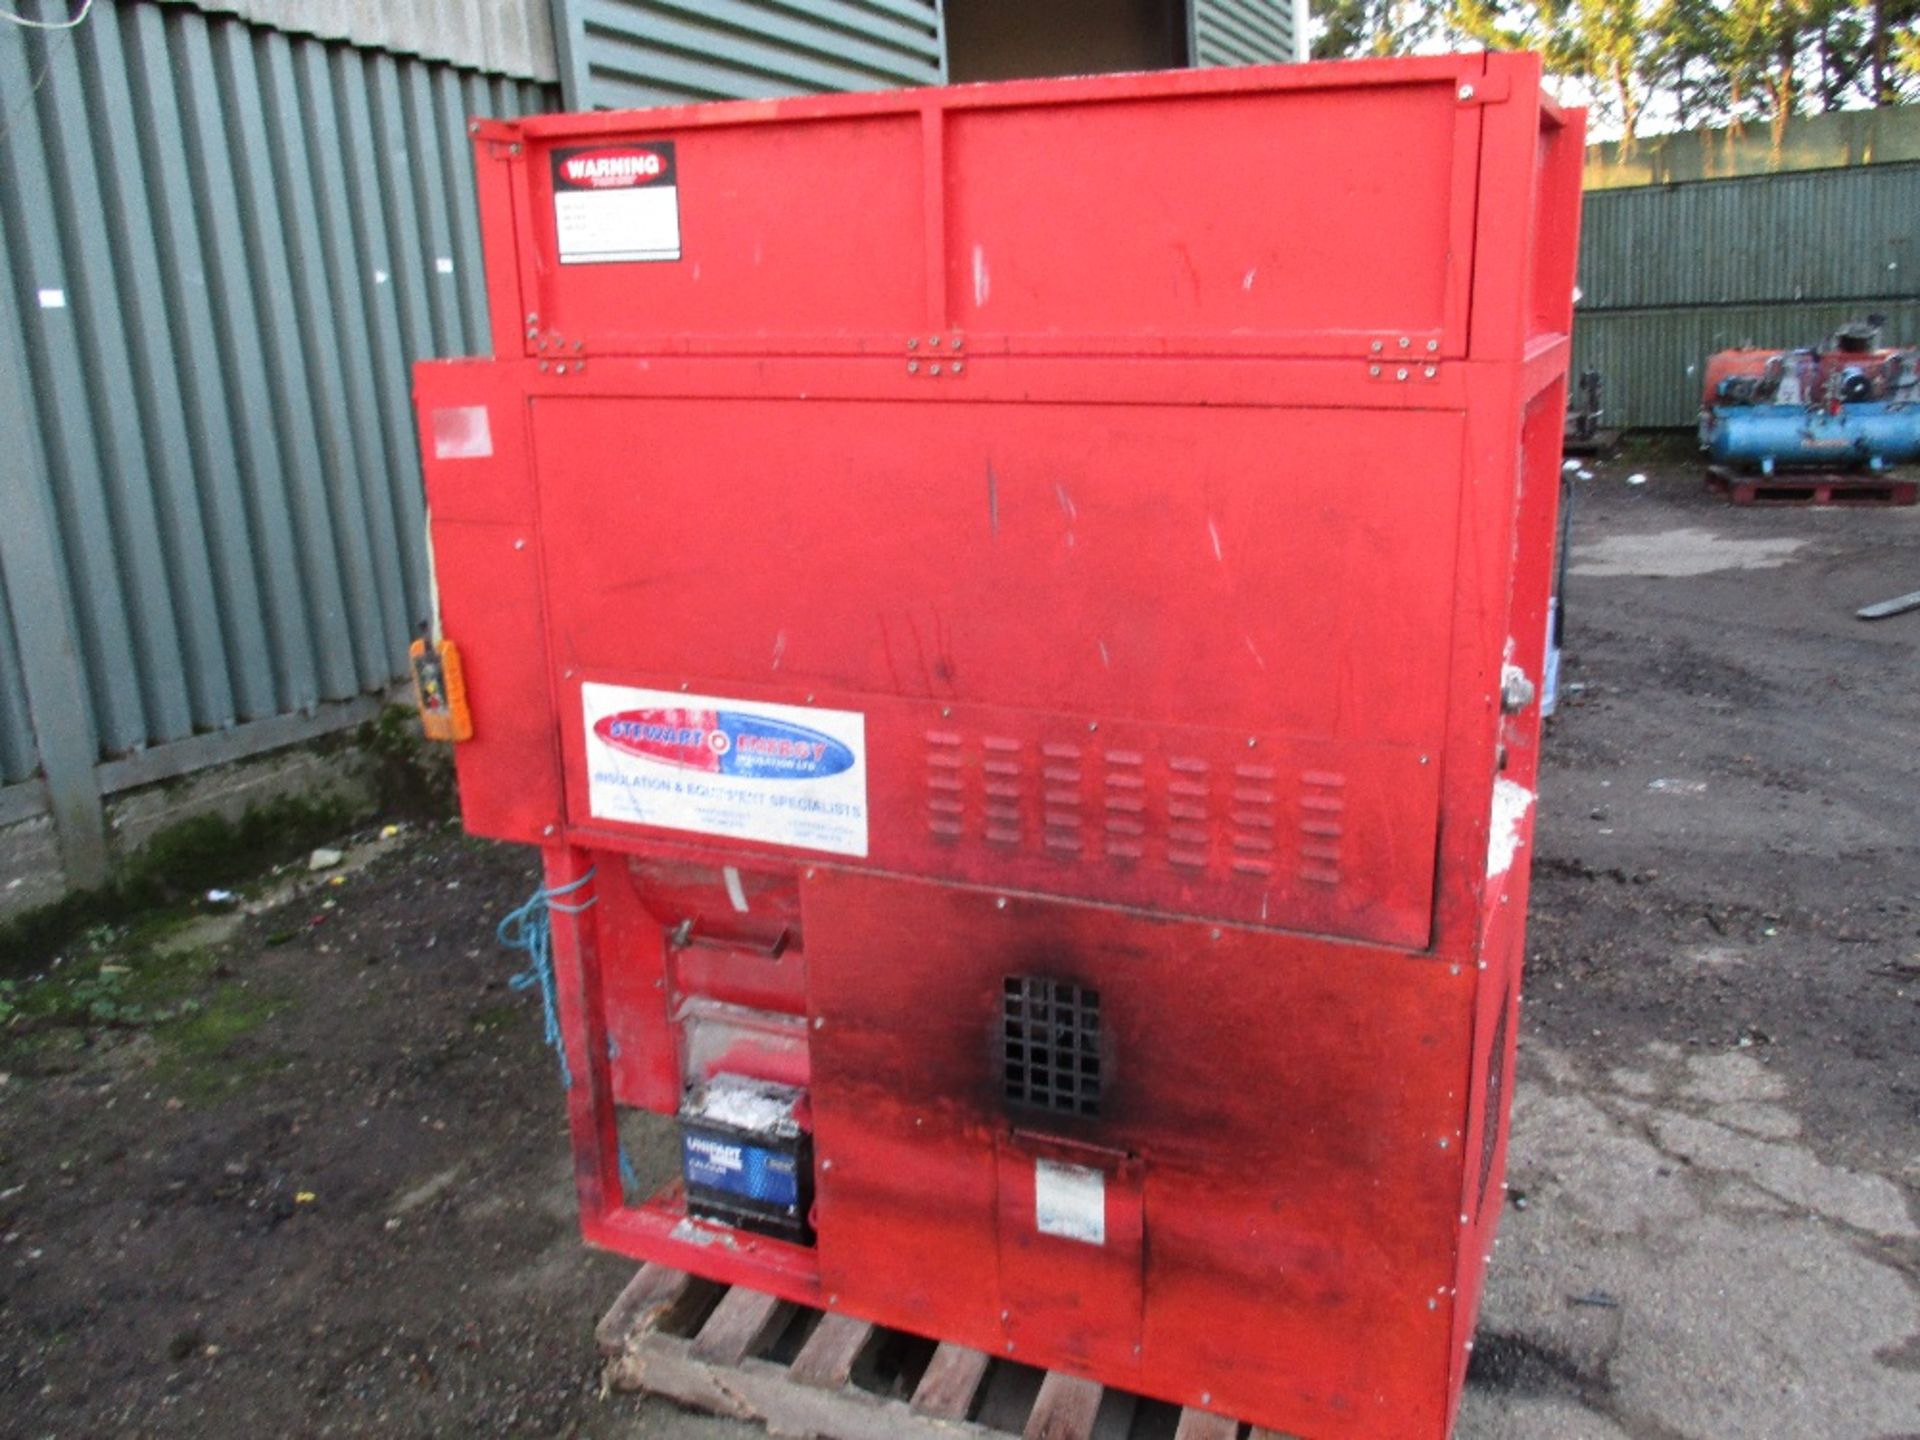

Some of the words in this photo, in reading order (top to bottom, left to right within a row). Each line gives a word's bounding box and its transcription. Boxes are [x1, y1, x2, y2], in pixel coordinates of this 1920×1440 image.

[567, 154, 660, 179] WARNING
[610, 721, 704, 747] STEWART
[736, 734, 827, 761] ENERGY
[595, 771, 671, 792] INSULATION
[674, 783, 683, 793] &
[686, 783, 765, 806] EQUMENT
[770, 793, 861, 818] SPECIALISTS
[687, 1137, 742, 1160] UNIPART
